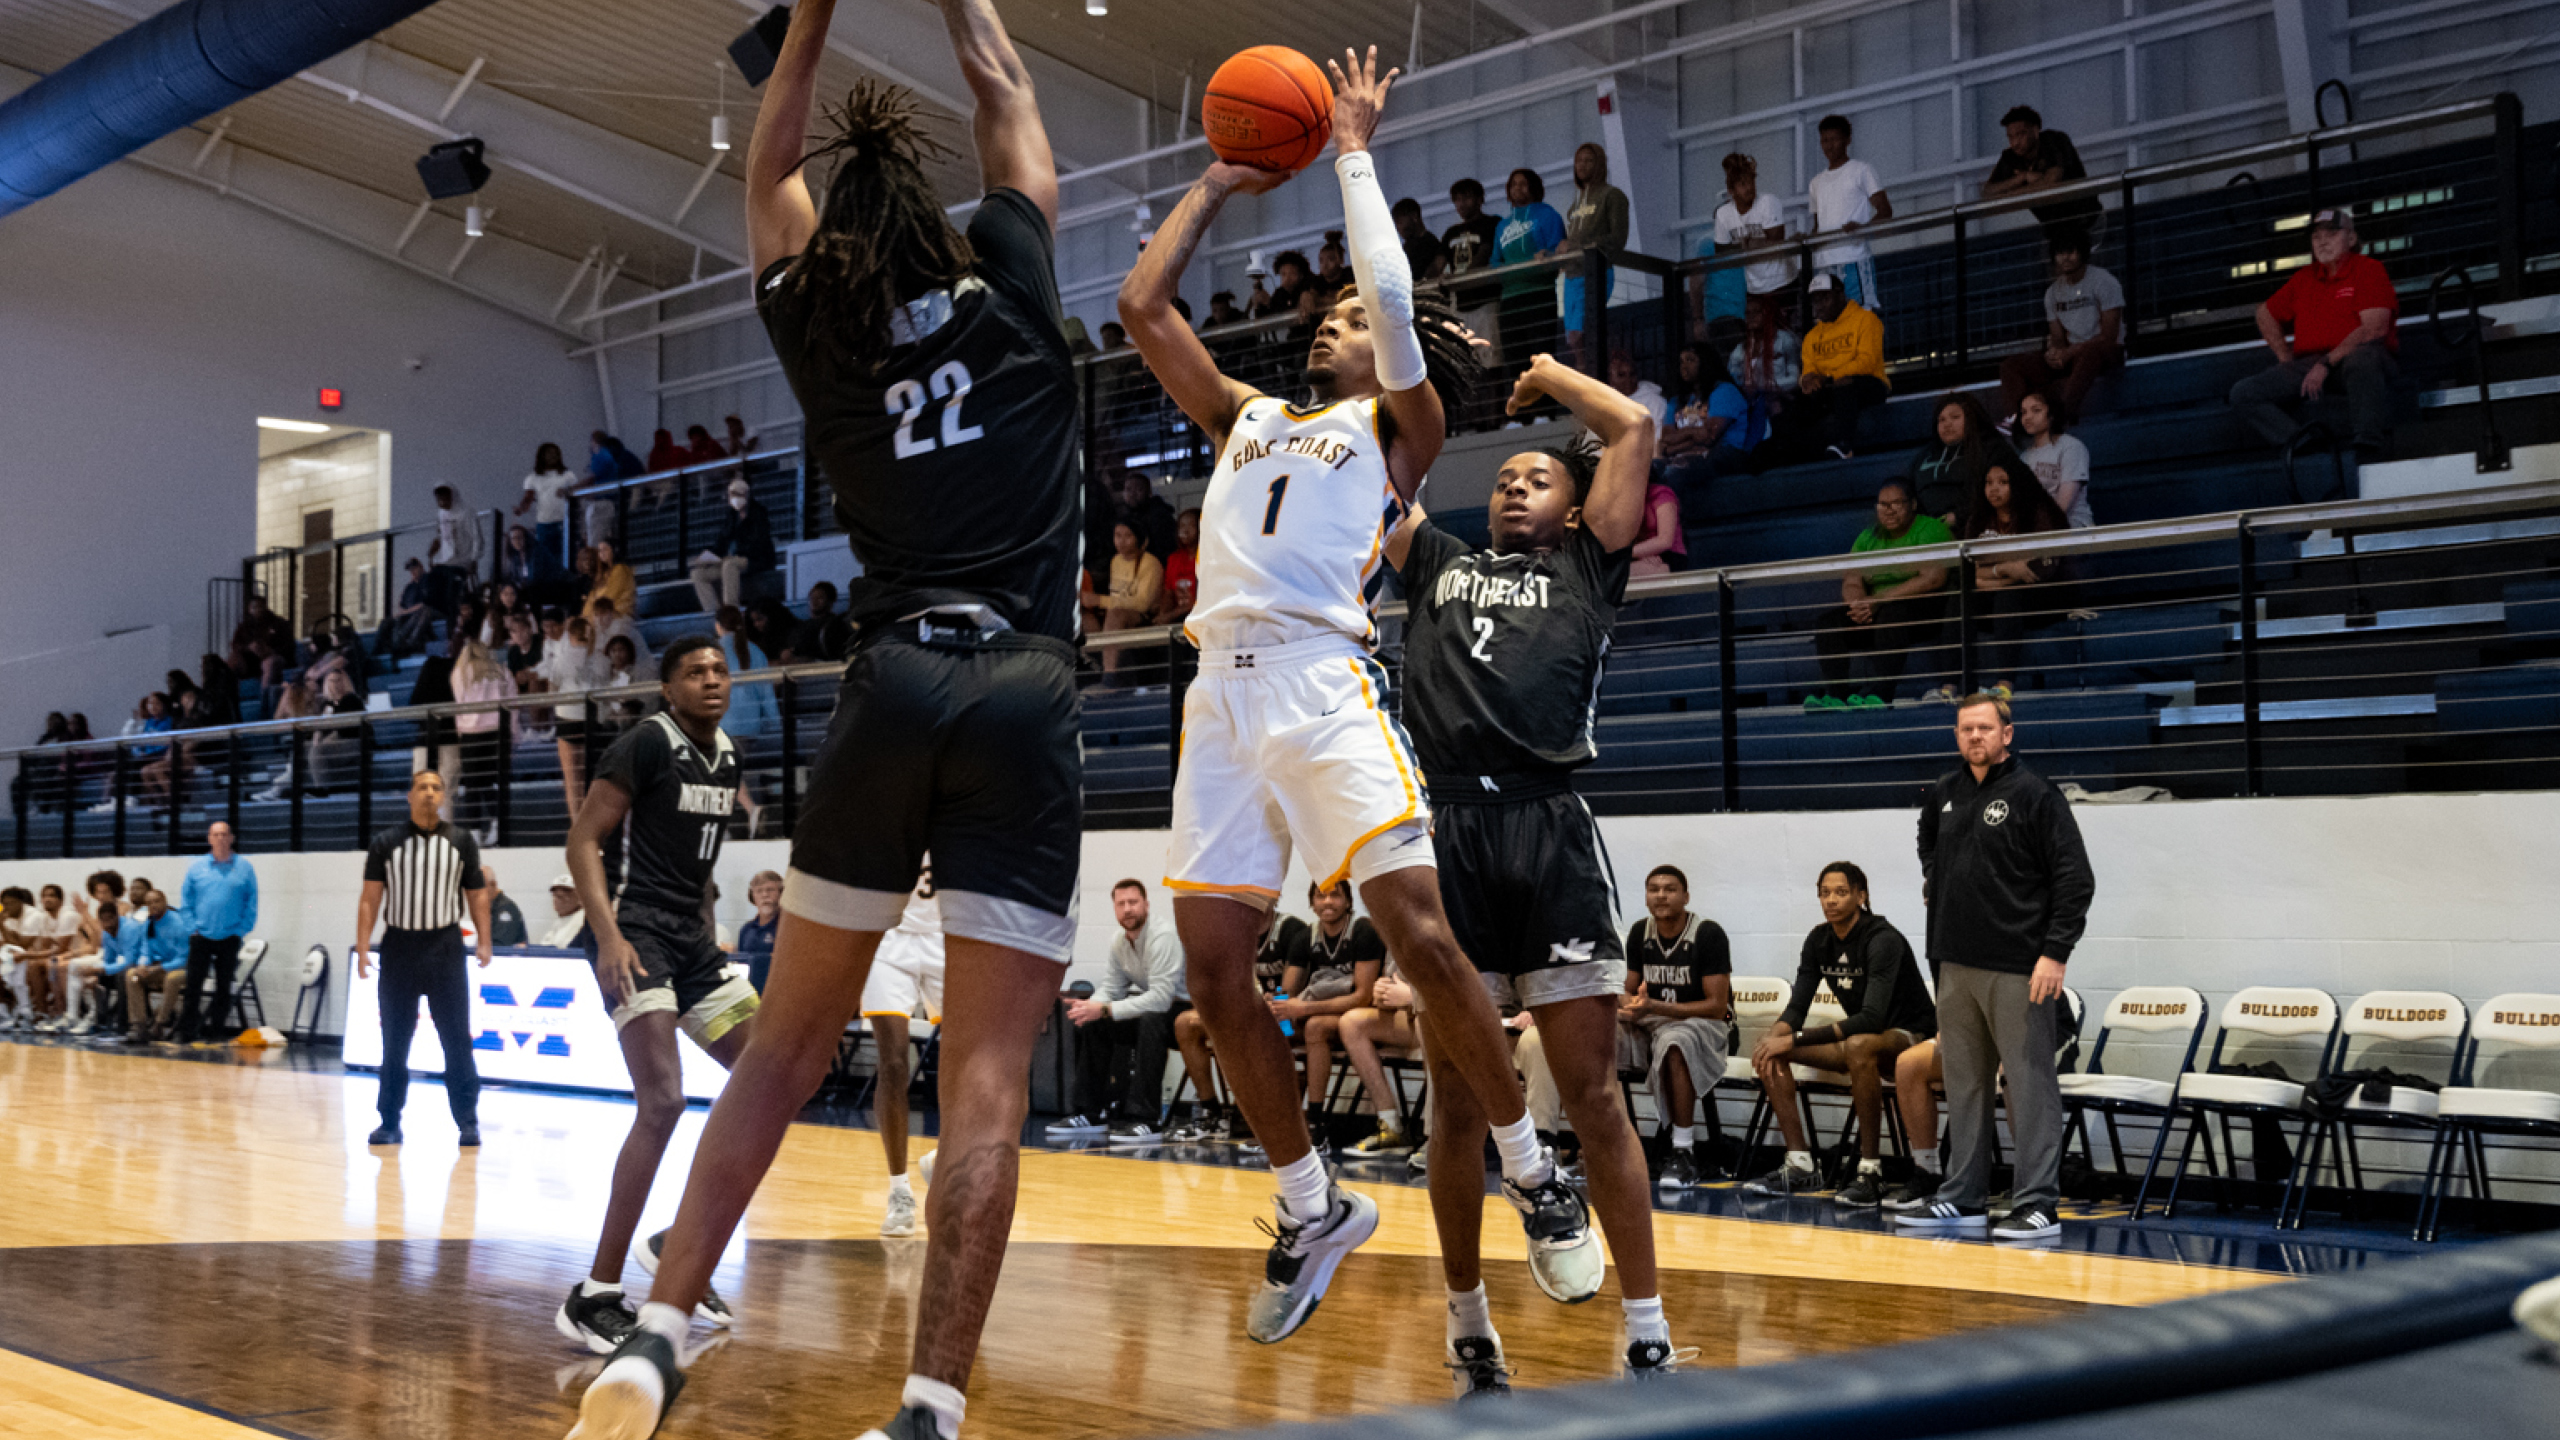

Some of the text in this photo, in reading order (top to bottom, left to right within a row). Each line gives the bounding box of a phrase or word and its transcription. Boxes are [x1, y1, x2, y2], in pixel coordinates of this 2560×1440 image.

[884, 359, 985, 460] 22
[1284, 435, 1358, 472] COAST
[1261, 473, 1291, 537] 1
[1434, 568, 1551, 609] NORTHEAST
[1471, 616, 1495, 662] 2
[698, 821, 719, 860] 11
[1643, 964, 1691, 985] NORTHEAST
[1731, 991, 1779, 1002] ULLDOGS
[2120, 1003, 2188, 1015] BULLDOGS
[2240, 1003, 2320, 1017] BULLDOGS
[2363, 1008, 2448, 1021] BULLDOGS
[2493, 1011, 2560, 1026] BULLDO
